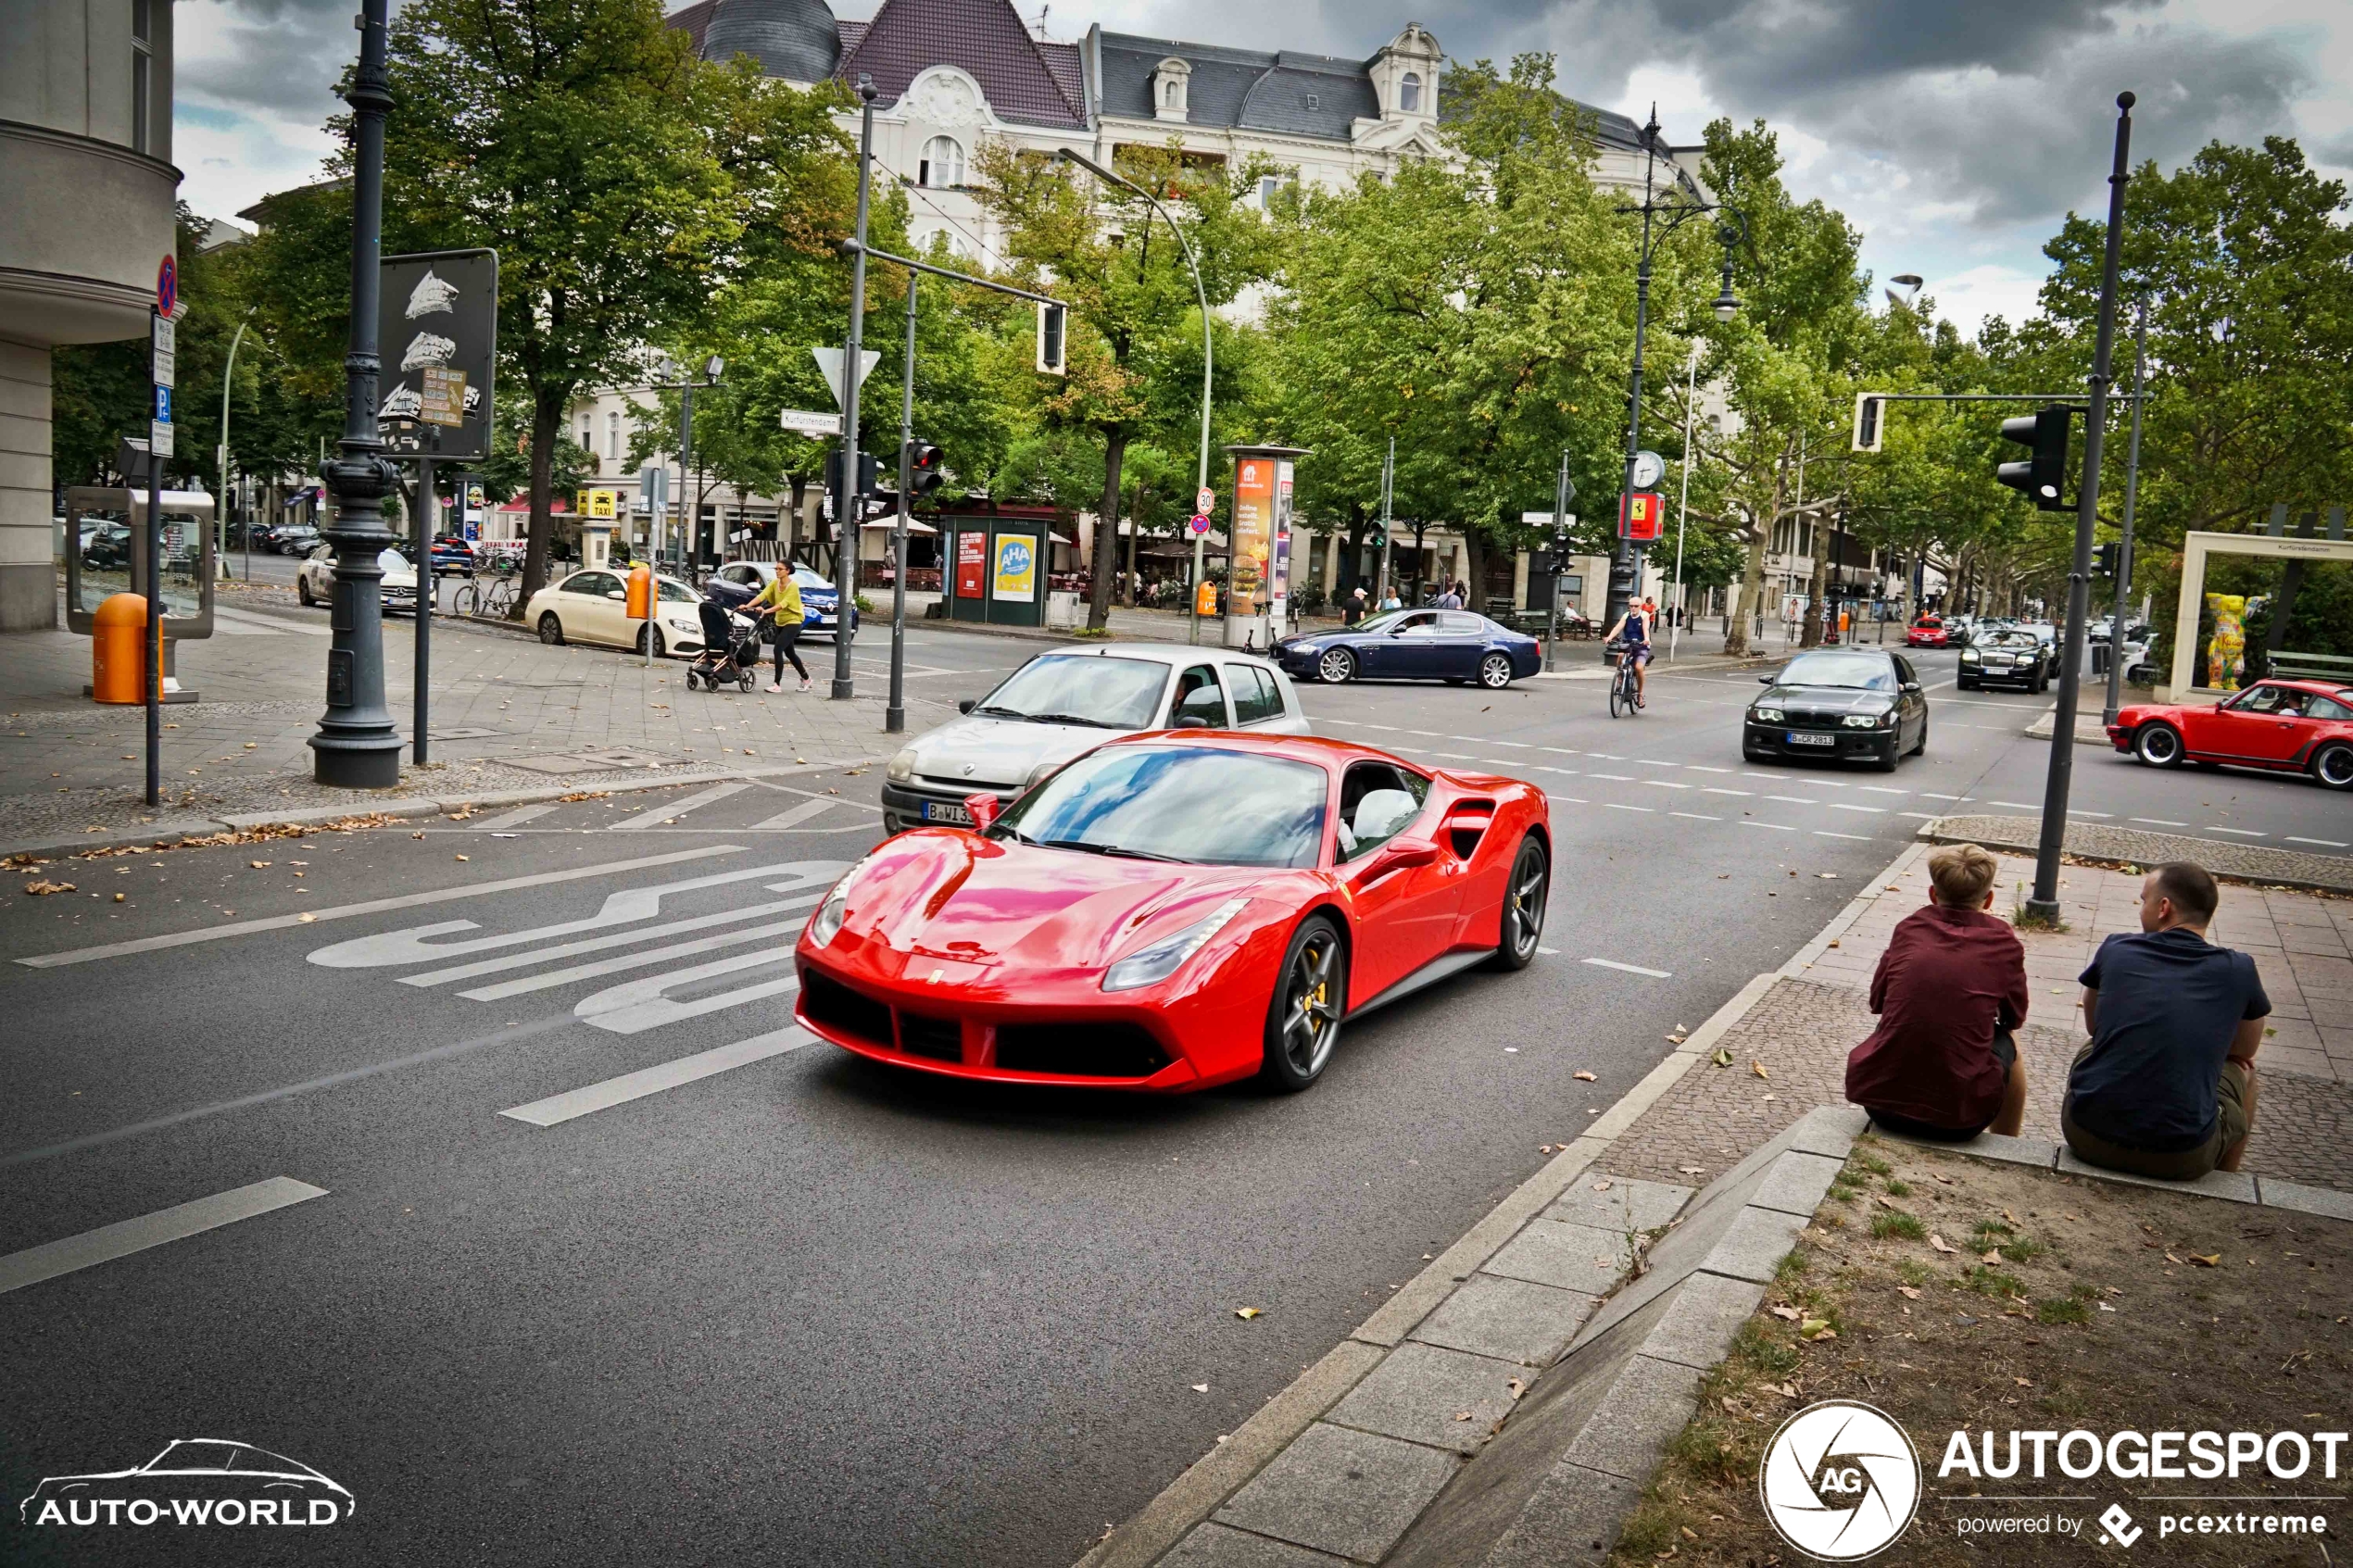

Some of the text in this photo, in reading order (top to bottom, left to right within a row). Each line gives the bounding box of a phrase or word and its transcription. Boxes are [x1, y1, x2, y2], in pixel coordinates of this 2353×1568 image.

[159, 390, 167, 418] P
[786, 414, 836, 426] Kurfürstendamm
[1201, 495, 1211, 507] 30
[595, 507, 610, 516] TAXI
[2278, 545, 2331, 553] Kurfürstendamm
[1001, 546, 1030, 567] AHA
[1813, 736, 1833, 745] 2813
[929, 805, 975, 822] B WI 3
